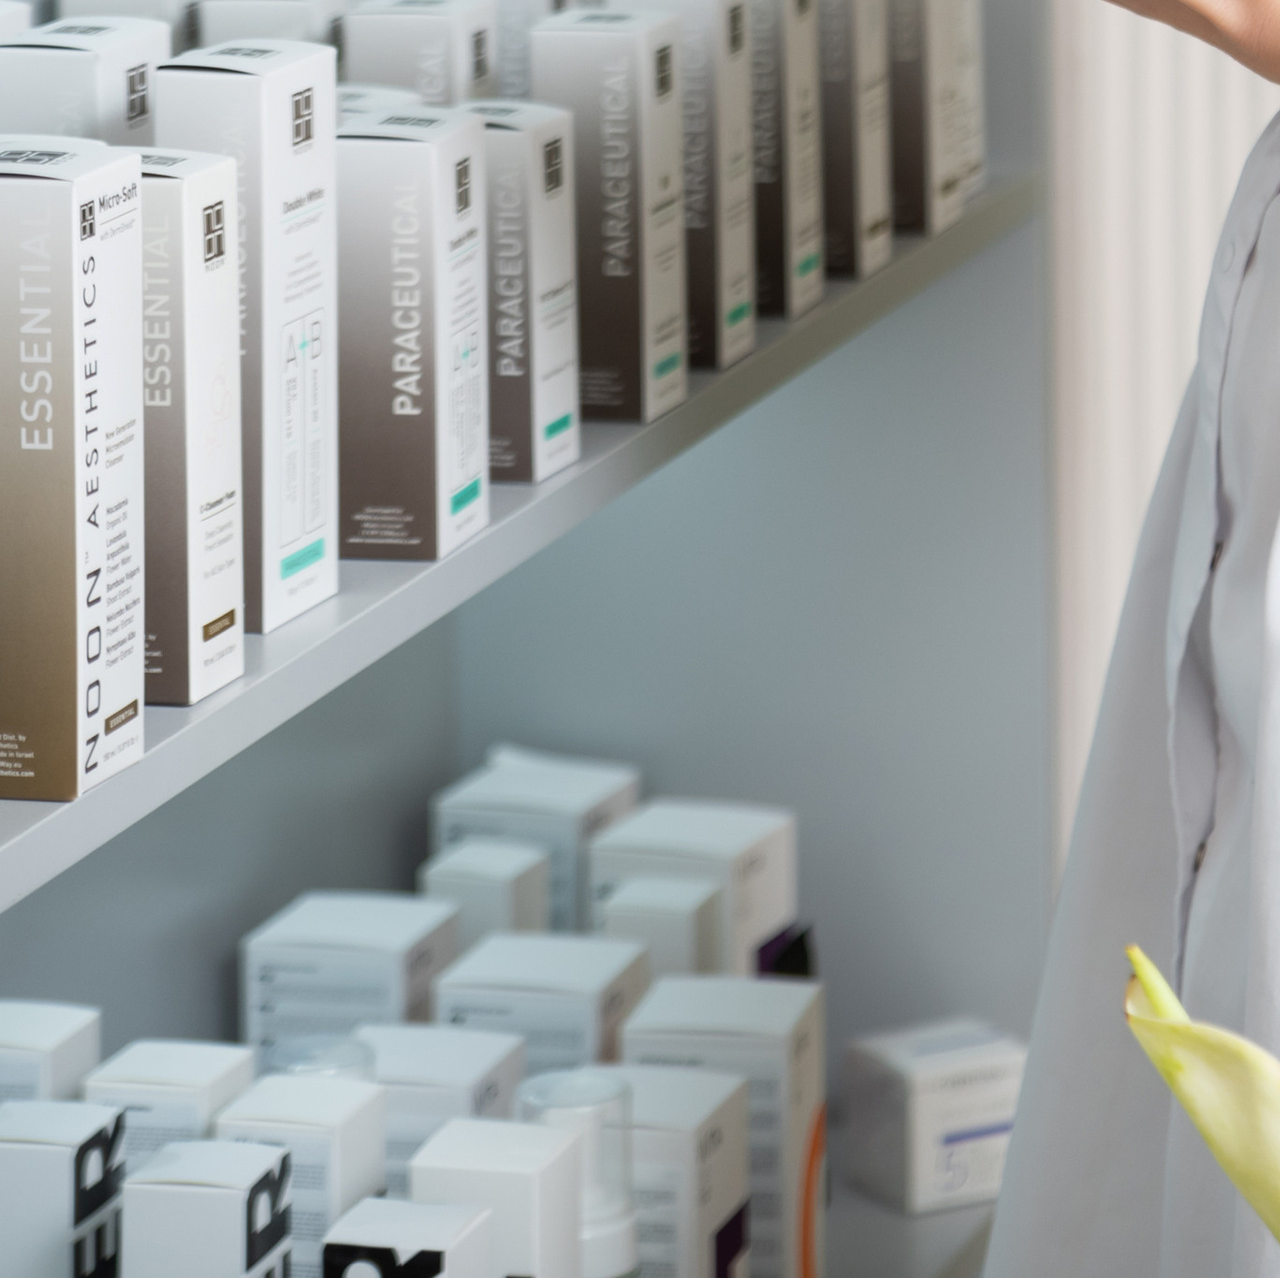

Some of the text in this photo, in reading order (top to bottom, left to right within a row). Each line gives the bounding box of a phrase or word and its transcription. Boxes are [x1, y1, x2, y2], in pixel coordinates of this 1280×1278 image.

[99, 182, 138, 213] Micro-Soft
[602, 57, 632, 277] PARACEUTICAL
[20, 209, 53, 451] ESSENTIAL
[82, 255, 99, 529] AESTHETICS
[143, 217, 172, 407] ESSENTIAL
[391, 182, 423, 416] PARACEUTICAL
[109, 707, 135, 729] ESSENTIAL
